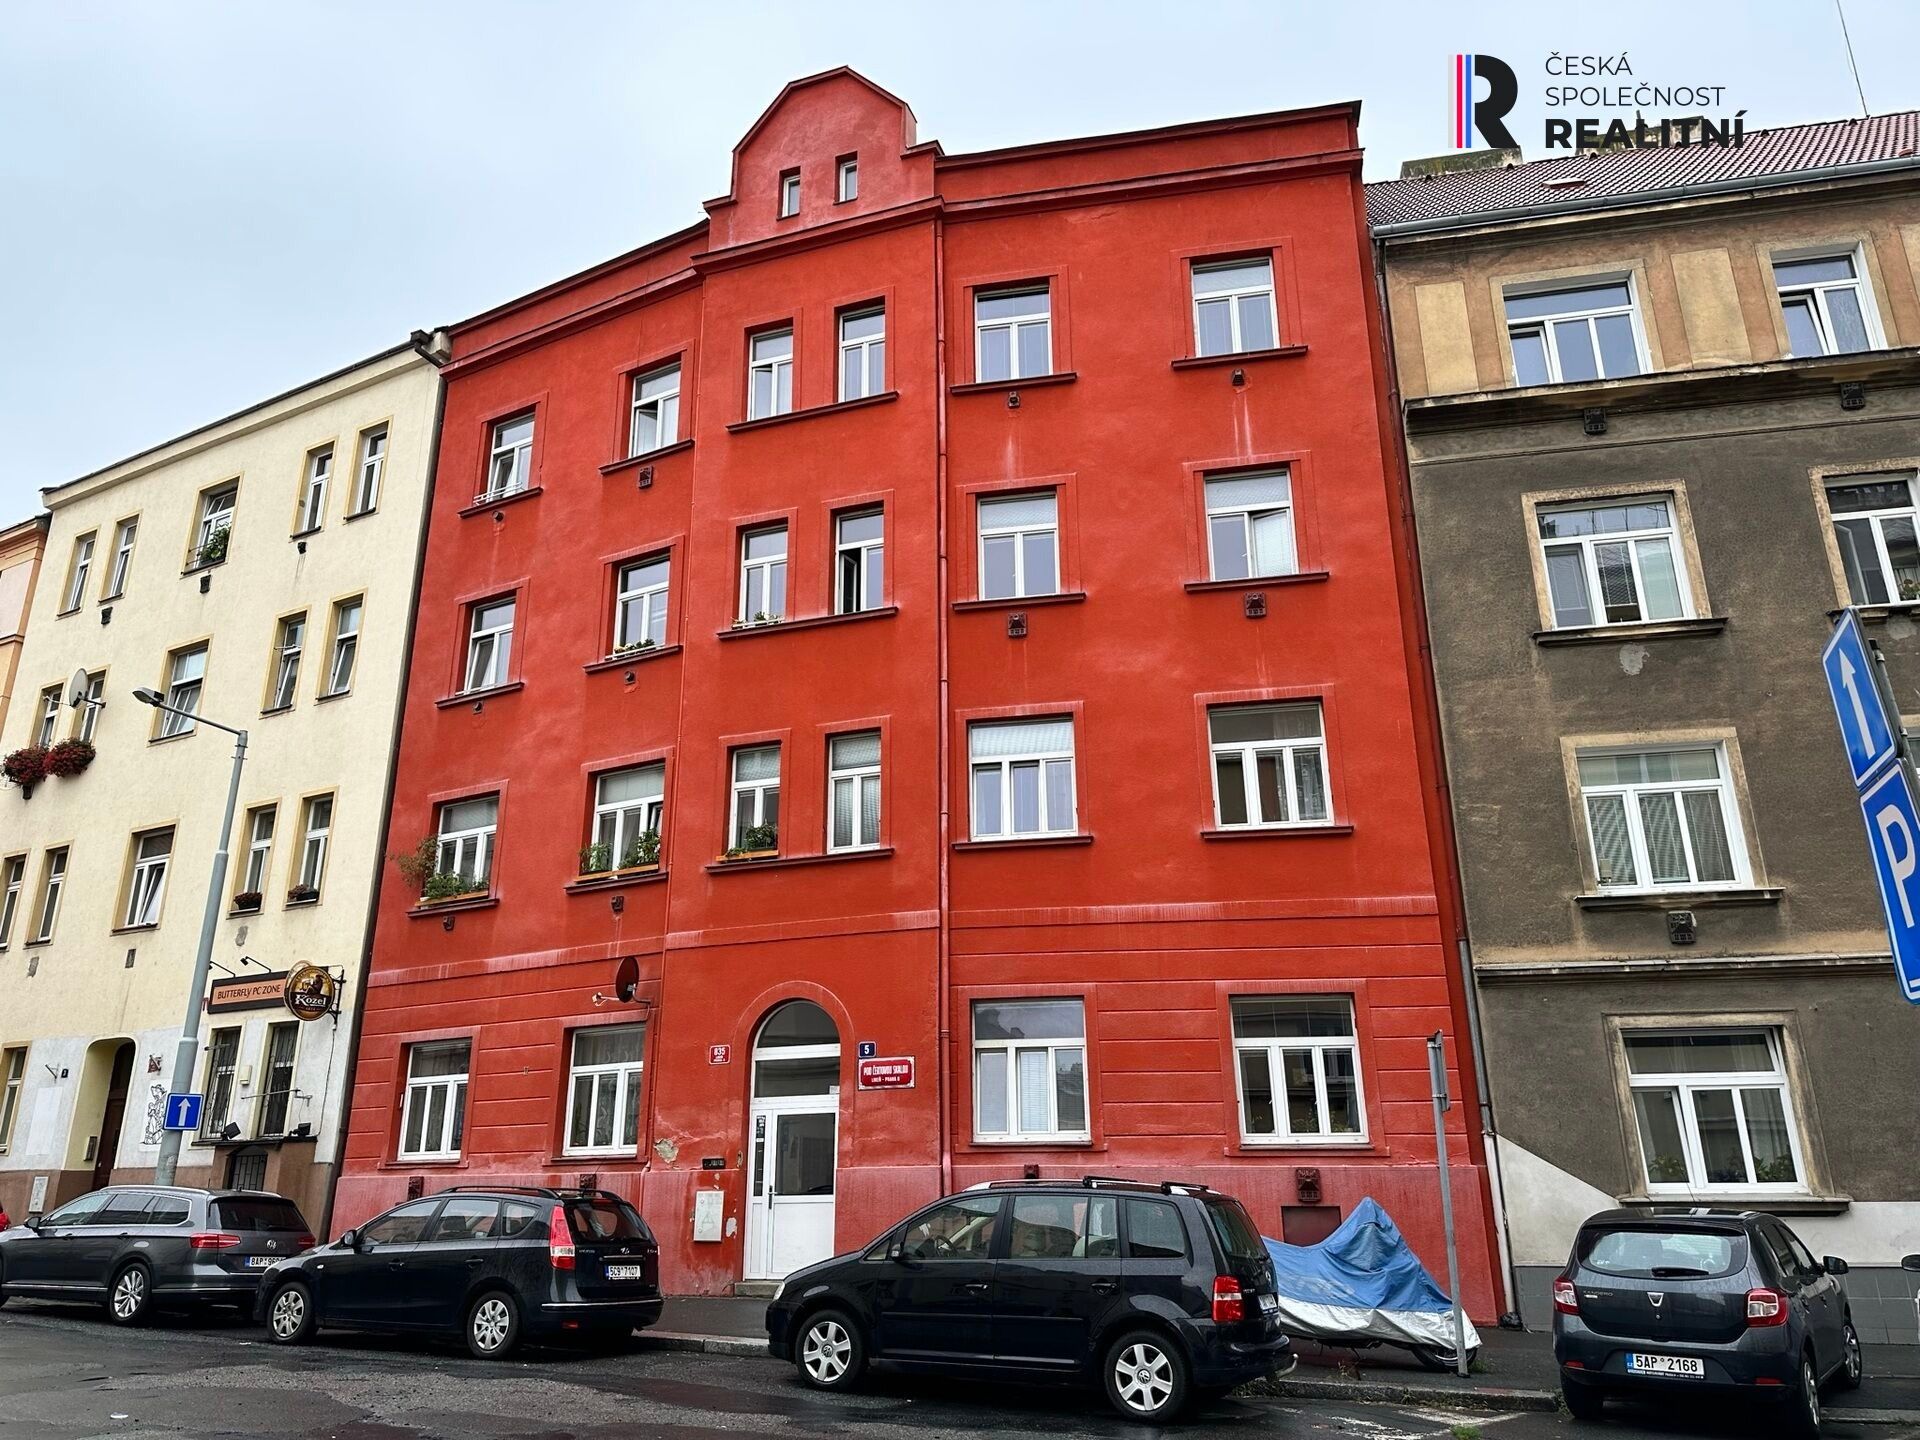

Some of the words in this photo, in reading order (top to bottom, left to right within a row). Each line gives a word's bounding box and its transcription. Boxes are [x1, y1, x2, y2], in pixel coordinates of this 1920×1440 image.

[1876, 804, 1916, 928] P
[217, 987, 252, 1000] BUTTERFLY
[252, 986, 262, 995] PC
[262, 984, 281, 994] ZONE
[294, 994, 327, 1007] Kozel
[864, 1045, 870, 1054] 5
[1635, 1355, 1658, 1369] 5AP
[1667, 1358, 1698, 1372] 2168
